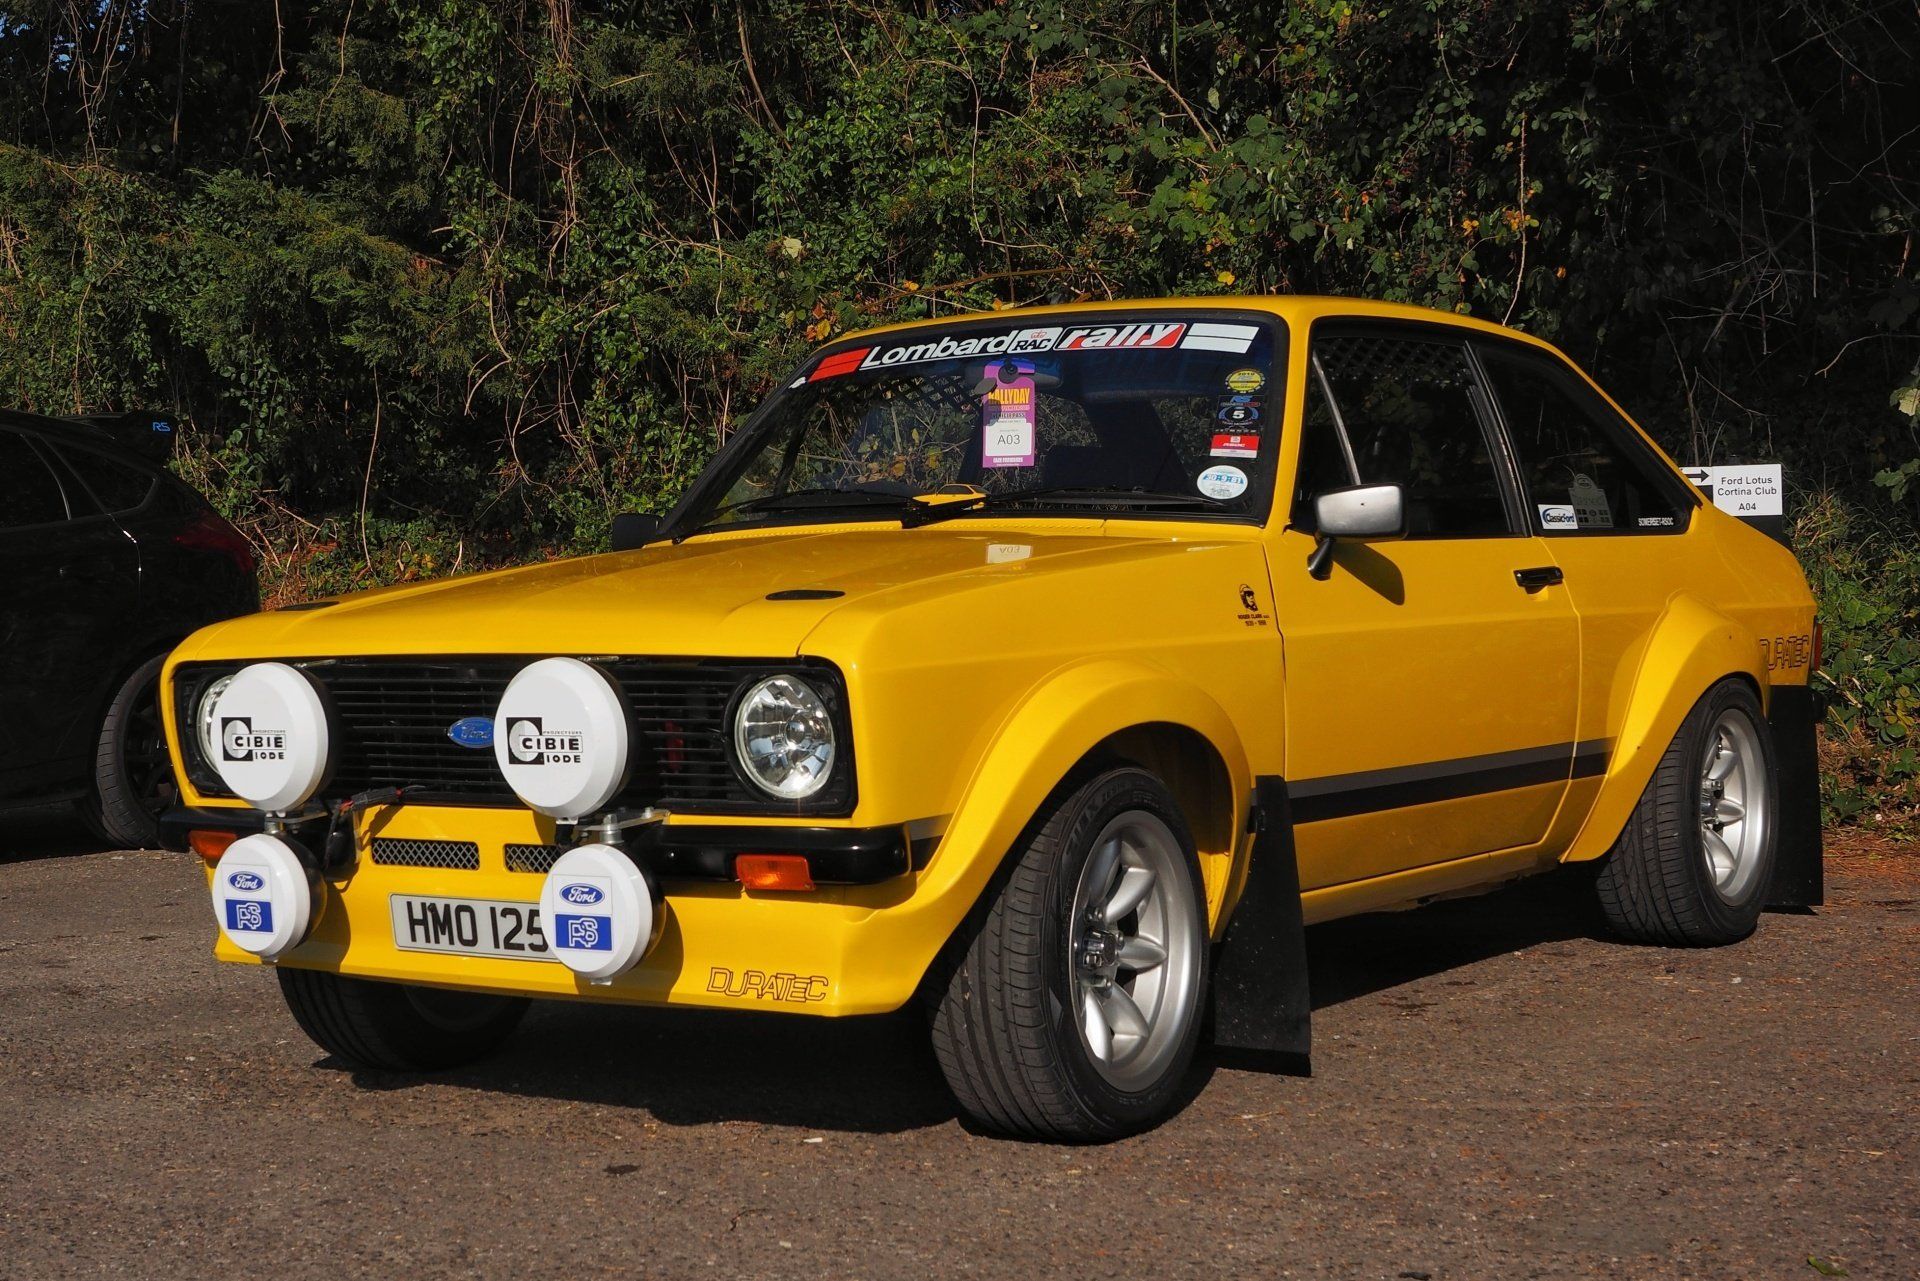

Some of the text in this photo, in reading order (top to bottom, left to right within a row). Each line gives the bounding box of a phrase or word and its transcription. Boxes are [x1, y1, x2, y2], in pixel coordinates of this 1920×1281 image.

[861, 324, 1182, 367] Lombard RAC rally
[1232, 410, 1245, 419] 5
[152, 422, 171, 432] RS
[997, 434, 1021, 445] A03
[1721, 475, 1773, 485] Ford Lotus
[1717, 486, 1777, 497] Cortina Club
[1738, 502, 1757, 511] A04
[254, 751, 285, 760] IODE
[546, 754, 582, 764] IODE
[234, 874, 260, 890] Ford
[567, 885, 597, 904] Ford
[237, 902, 262, 930] RS
[406, 900, 549, 952] HMO 125
[568, 916, 599, 948] RS
[706, 966, 829, 1003] DURATEC
